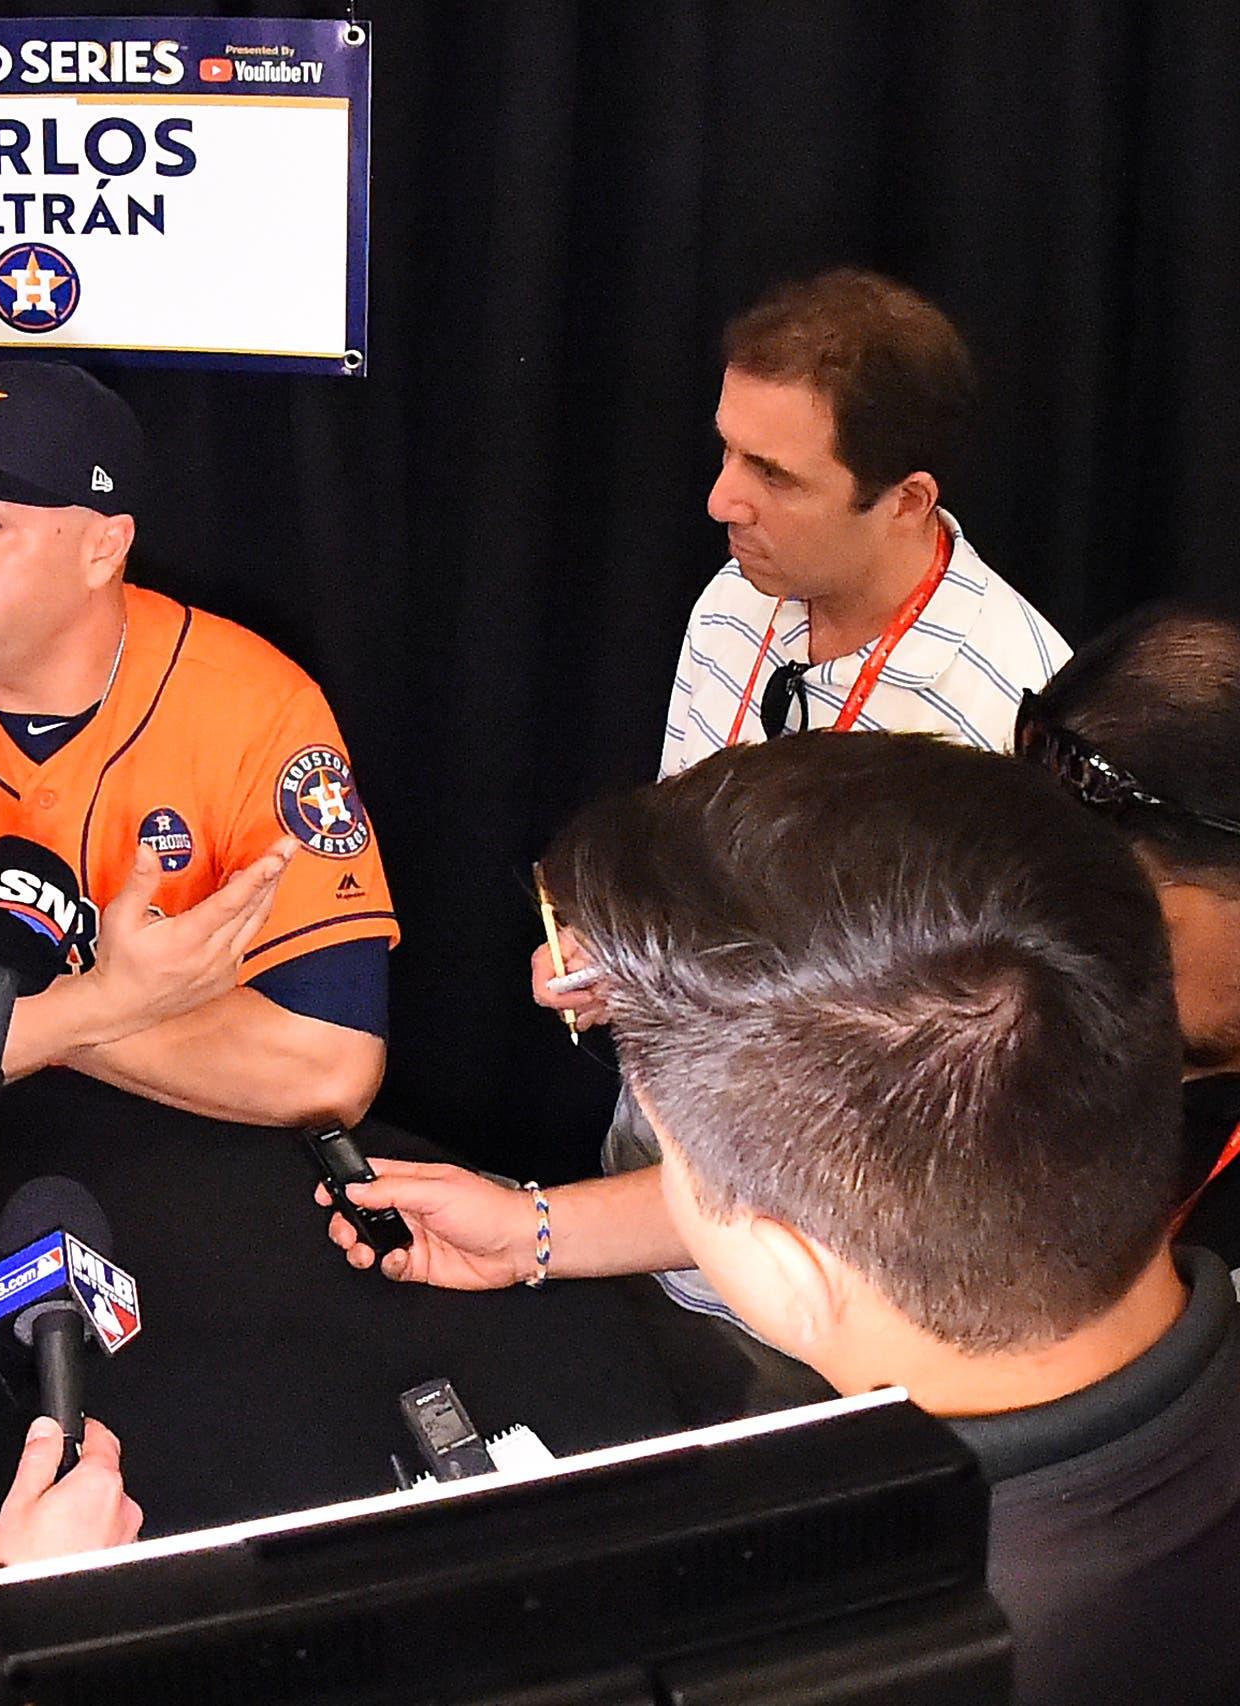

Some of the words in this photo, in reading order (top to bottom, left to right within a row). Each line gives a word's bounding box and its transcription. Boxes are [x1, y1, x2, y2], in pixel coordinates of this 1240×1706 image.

[20, 41, 185, 85] SERIES
[225, 45, 278, 56] Presented
[283, 752, 350, 792] HOUSTON
[308, 822, 367, 853] ASTROS
[70, 1242, 134, 1300] MLB
